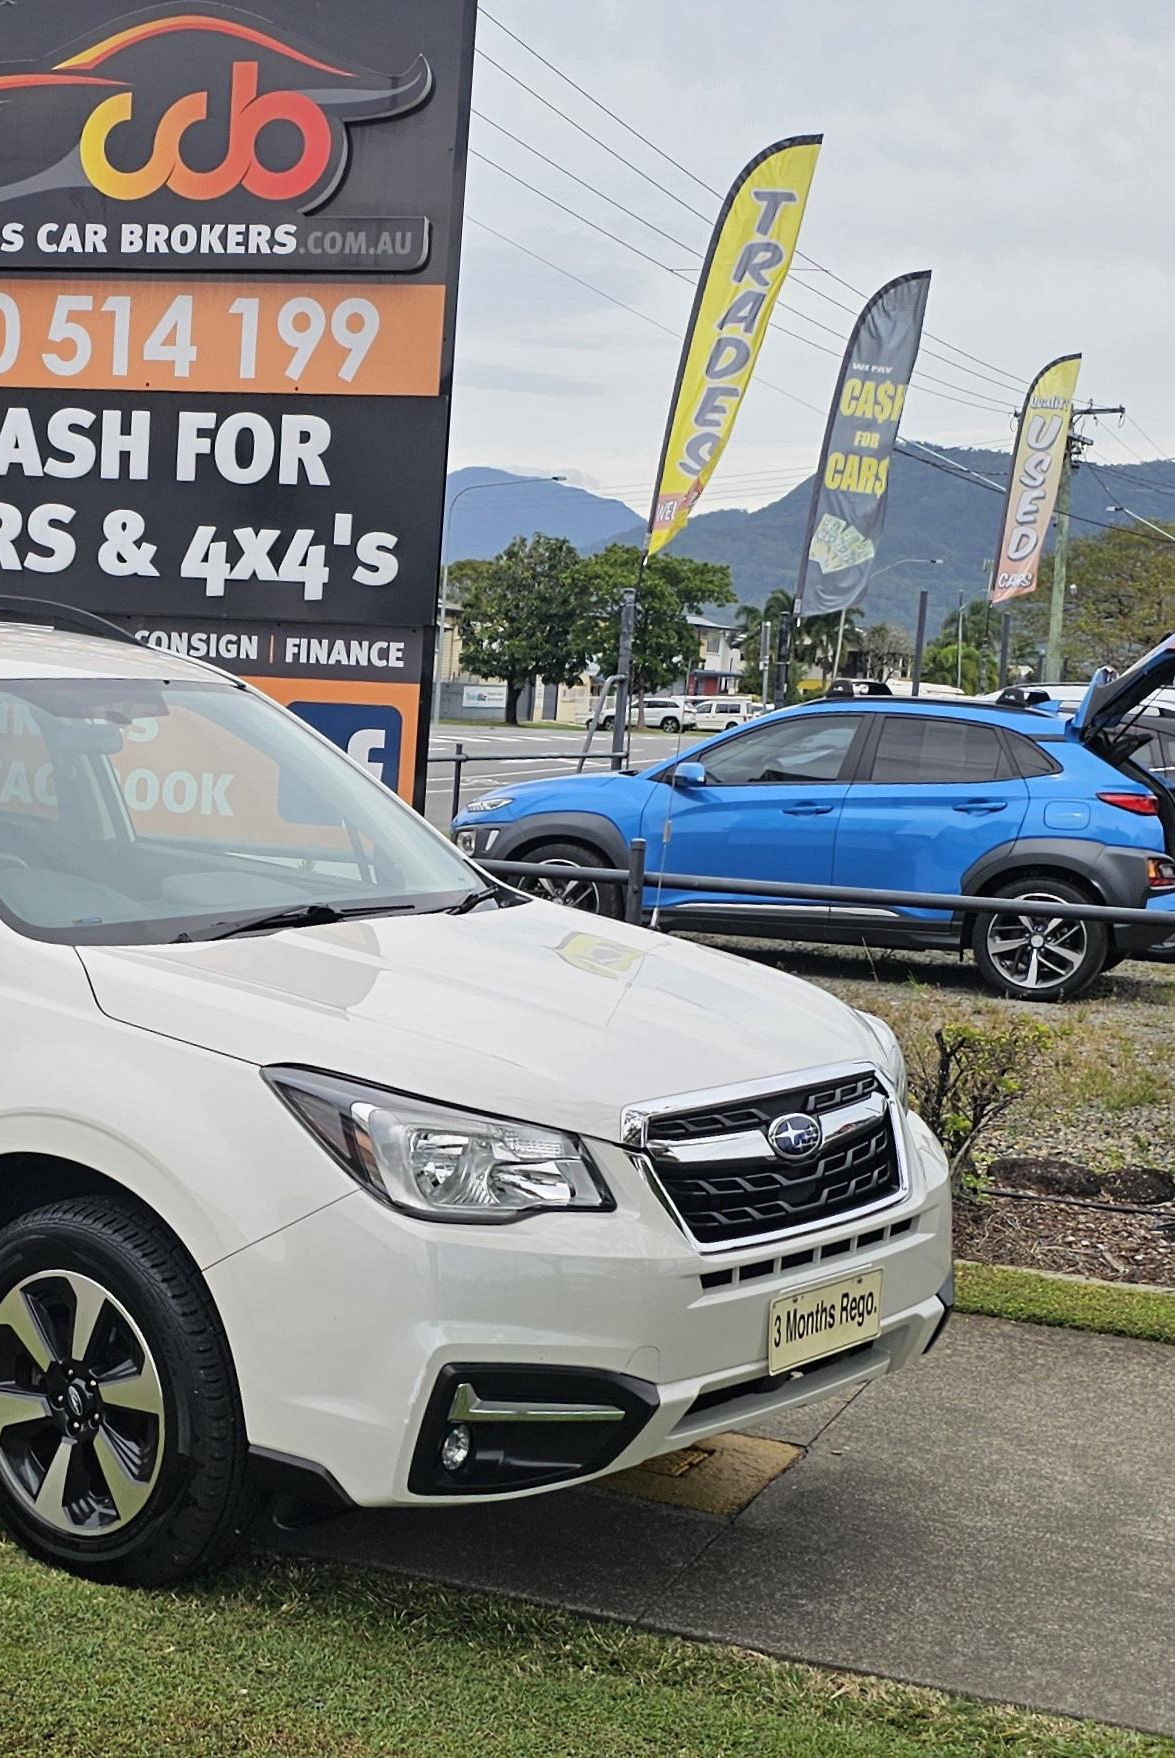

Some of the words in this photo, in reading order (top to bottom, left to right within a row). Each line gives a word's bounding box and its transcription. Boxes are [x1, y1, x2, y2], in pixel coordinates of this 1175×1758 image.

[36, 223, 108, 253] CAR
[41, 294, 197, 377] 514
[228, 297, 380, 382] 199
[677, 190, 797, 479] TRADES
[871, 364, 893, 375] PAY
[176, 411, 332, 486] FOR
[854, 431, 880, 449] FOR
[1007, 414, 1064, 562] USED
[97, 509, 160, 578] &
[998, 572, 1033, 589] CARS
[285, 637, 405, 668] FINANCE
[774, 1314, 782, 1348] 3
[786, 1300, 836, 1343] Months
[840, 1291, 877, 1327] Rego.
